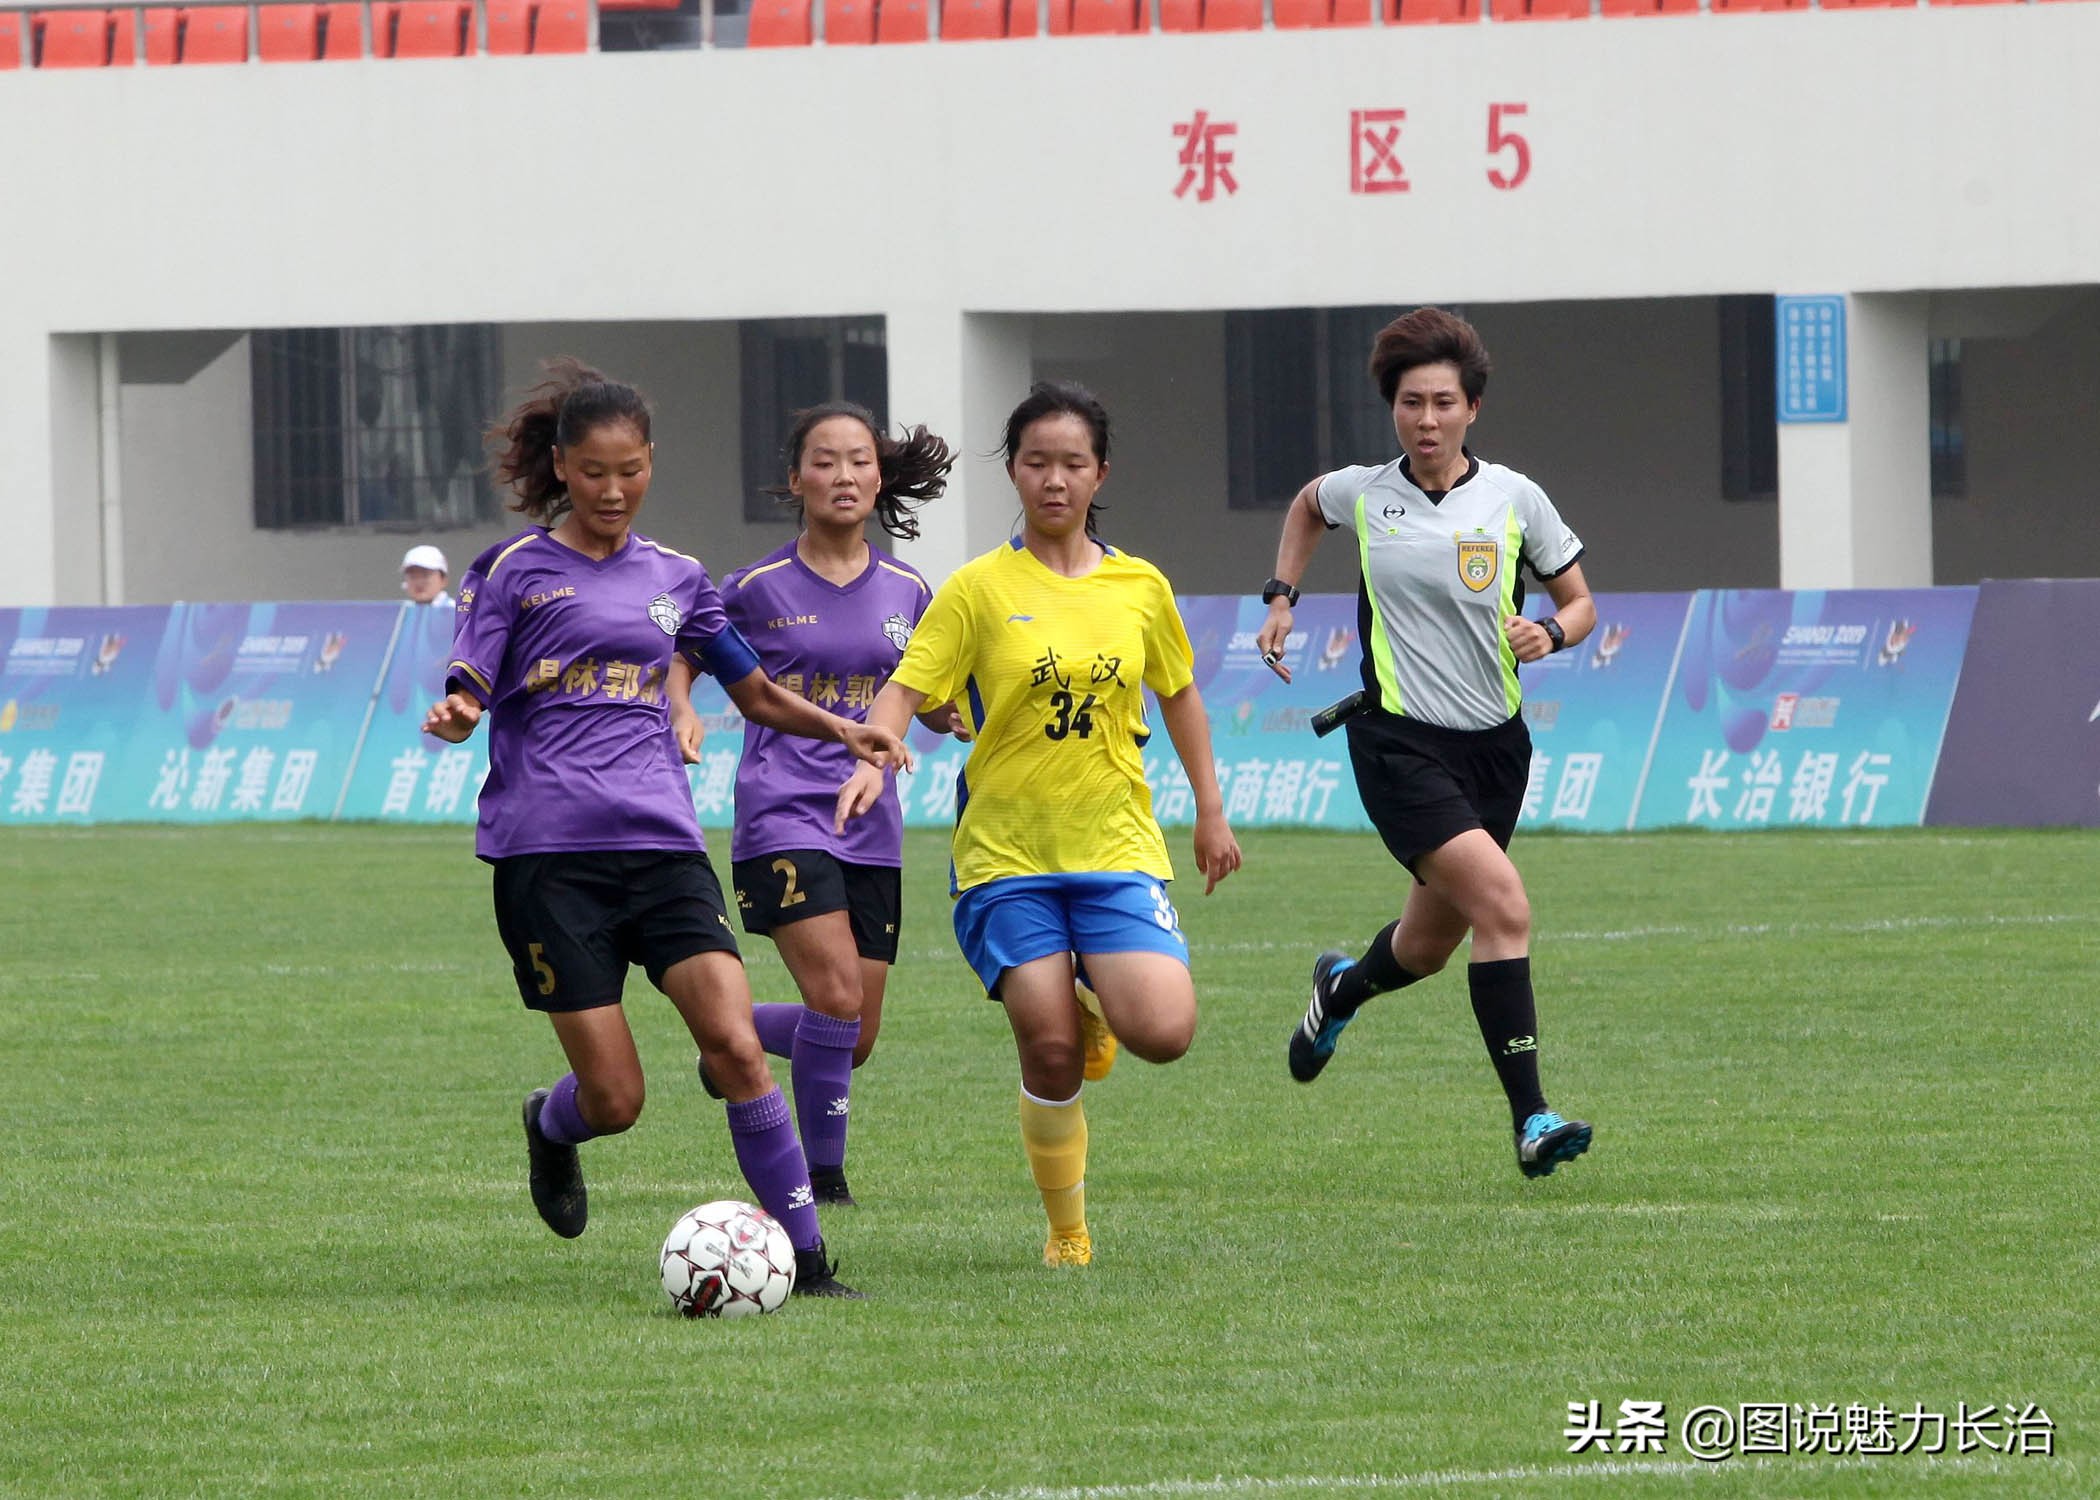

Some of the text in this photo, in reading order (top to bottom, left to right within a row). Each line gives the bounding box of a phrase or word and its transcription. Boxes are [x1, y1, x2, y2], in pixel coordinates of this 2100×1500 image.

[1486, 103, 1531, 191] 5
[521, 586, 576, 609] KELME
[767, 614, 818, 631] KELME
[1030, 646, 1126, 691] 武汉
[1044, 690, 1097, 741] 34
[148, 747, 319, 813] 沁新集团
[382, 746, 489, 815] 首钢
[1686, 748, 1892, 825] 长治银行
[771, 858, 807, 909] 2
[528, 943, 556, 996] 5
